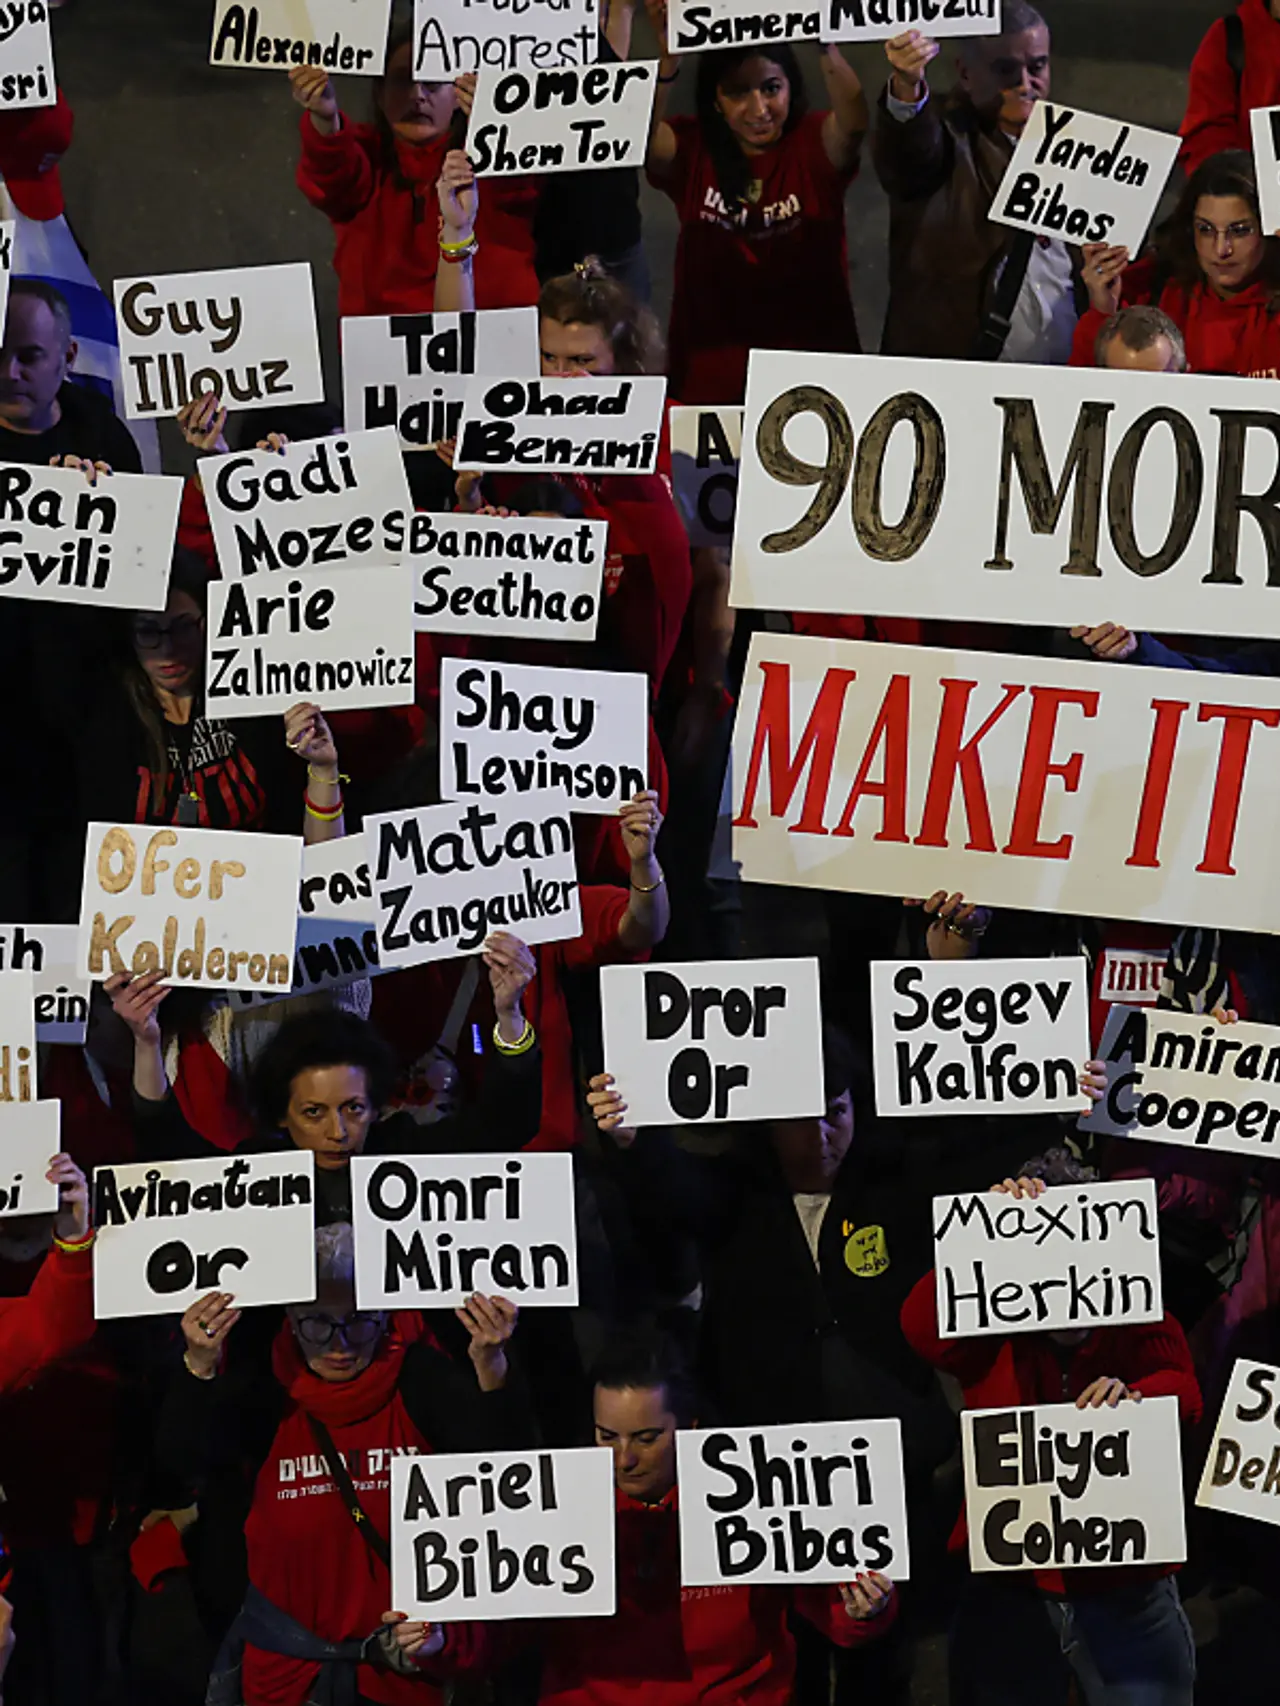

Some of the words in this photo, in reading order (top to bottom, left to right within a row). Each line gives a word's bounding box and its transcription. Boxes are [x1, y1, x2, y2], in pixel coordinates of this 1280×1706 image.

[0, 0, 46, 42] ya
[214, 4, 373, 70] Alexander
[468, 124, 563, 173] Shem
[569, 119, 630, 164] Tov
[1034, 104, 1148, 188] Yarden
[1003, 172, 1116, 242] Bibas
[121, 282, 241, 352] Guy
[390, 312, 475, 375] Tal
[129, 353, 294, 411] Illouz
[484, 381, 632, 418] Ohad
[216, 440, 358, 513] Gadi
[755, 382, 946, 564] 90
[234, 509, 405, 575] Mozes
[410, 514, 595, 565] Bannawat
[217, 580, 335, 638] Arie
[414, 566, 594, 623] Seathao
[208, 648, 412, 700] Zalmanowicz
[455, 668, 595, 750] Shay
[453, 742, 644, 801] Levinson
[731, 661, 1100, 861] MAKE
[1126, 697, 1280, 876] IT
[97, 826, 246, 899] Ofer
[376, 804, 571, 880] Matan
[380, 868, 578, 950] Zangauker
[87, 911, 288, 985] Kalderon
[644, 970, 787, 1040] Dror
[893, 966, 1072, 1044] Segev
[667, 1047, 749, 1119] Or
[894, 1041, 1077, 1105] Kalfon
[94, 1159, 312, 1226] Avinatan
[366, 1161, 523, 1222] Omri
[935, 1194, 1155, 1245] Maxim
[384, 1227, 570, 1292] Miran
[945, 1260, 1153, 1333] Herkin
[403, 1455, 558, 1521] Ariel
[701, 1433, 872, 1513] Shiri
[972, 1411, 1130, 1500] Eliya
[715, 1509, 894, 1576] Bibas
[983, 1496, 1147, 1566] Cohen
[413, 1530, 595, 1602] Bibas
